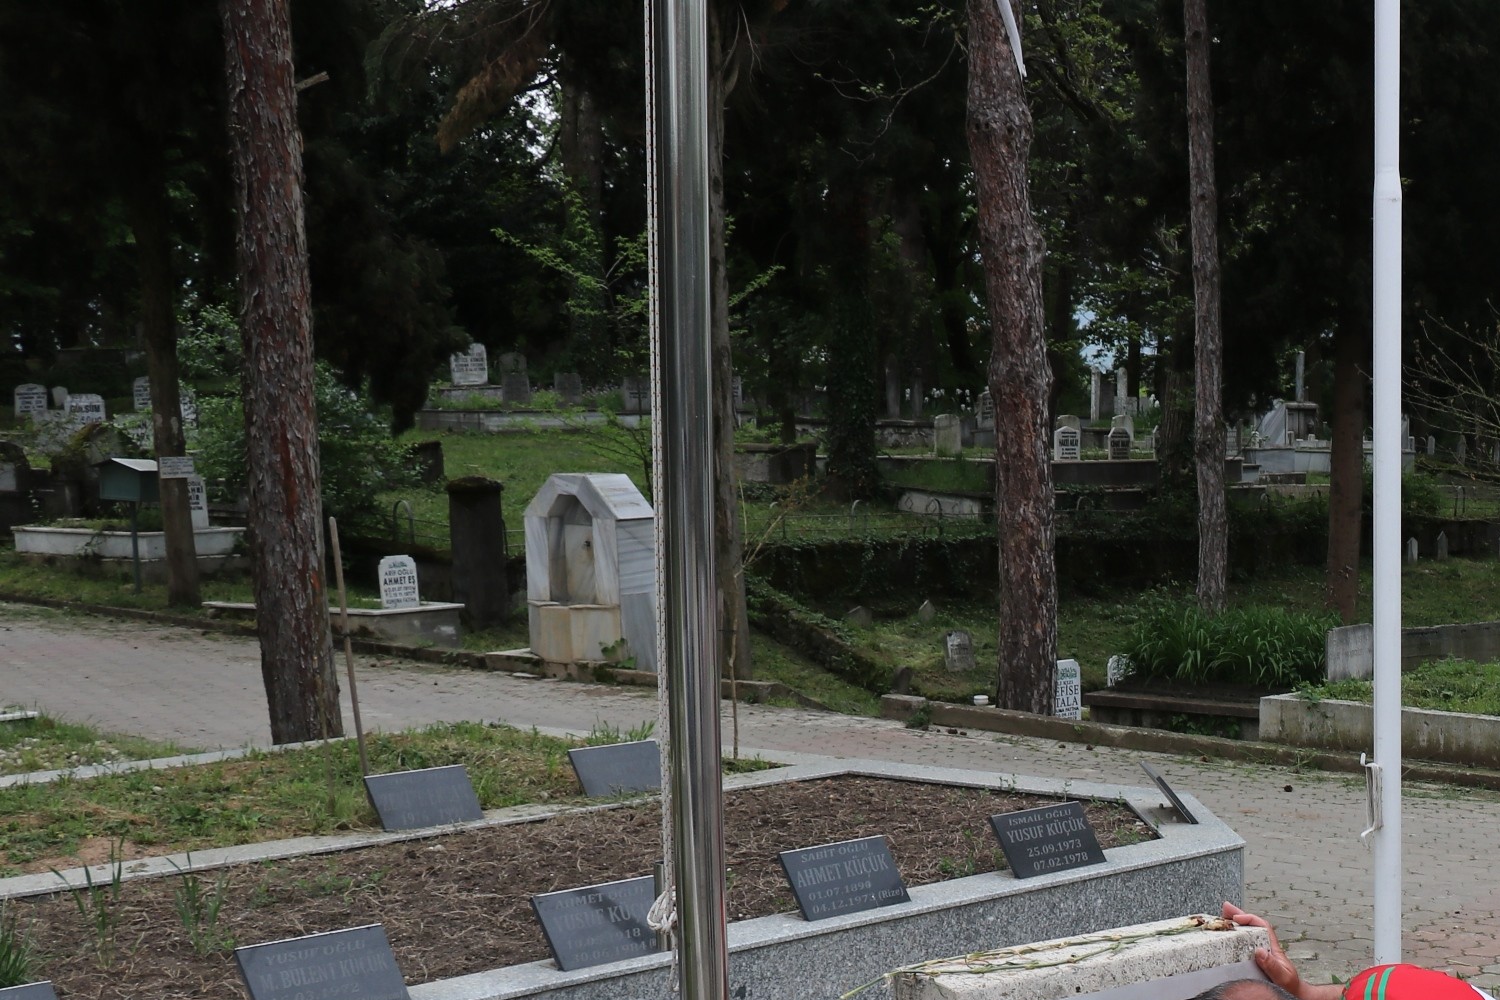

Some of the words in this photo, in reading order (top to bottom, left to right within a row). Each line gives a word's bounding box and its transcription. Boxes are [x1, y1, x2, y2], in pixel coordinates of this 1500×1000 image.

[383, 576, 406, 586] AHMET
[1056, 684, 1079, 697] EFİSE
[1045, 808, 1072, 819] OĞLU
[1006, 825, 1044, 844] YUSUF
[1046, 816, 1087, 837] KÜÇÜK
[838, 842, 869, 856] OĞLU
[1026, 838, 1082, 858] 25.09.1973
[1033, 851, 1089, 871] 07.02.1978
[796, 863, 842, 888] AHMET
[843, 853, 889, 878] KÜÇÜK
[878, 888, 905, 902] (Rize)
[265, 947, 319, 966] YUSUF
[323, 939, 366, 956] OĞLU
